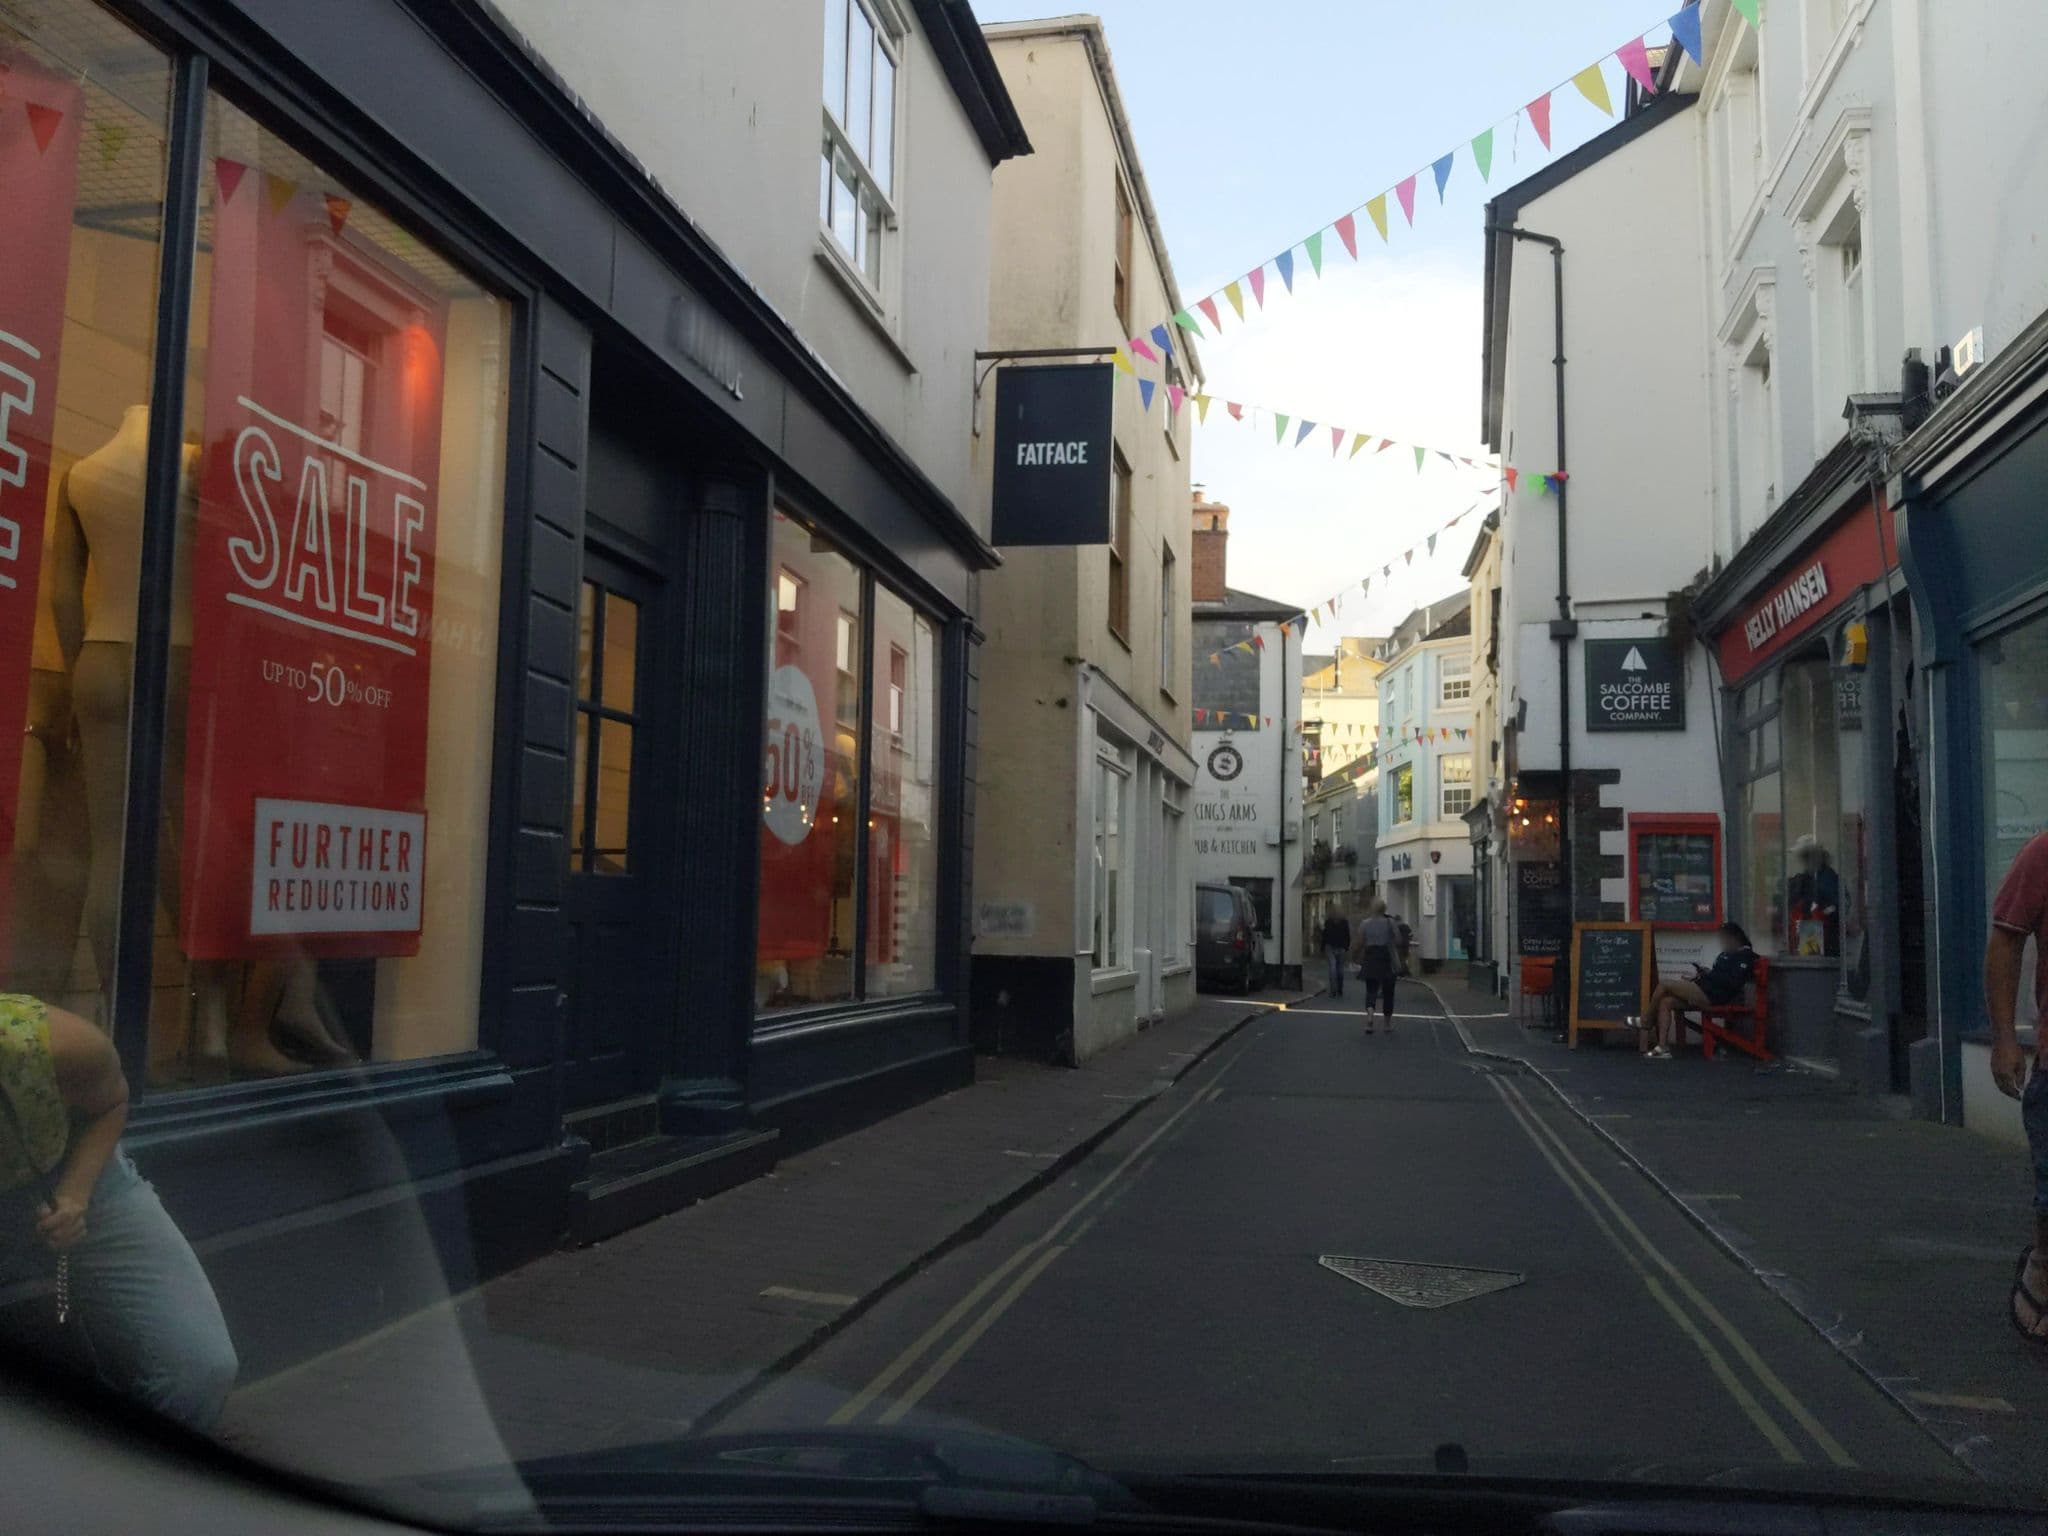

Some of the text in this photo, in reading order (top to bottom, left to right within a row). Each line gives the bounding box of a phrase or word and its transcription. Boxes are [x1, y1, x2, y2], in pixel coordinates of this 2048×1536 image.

[1016, 440, 1089, 466] FATFACE
[228, 425, 424, 636] SALE
[1744, 561, 1828, 660] HELLY HANSEN
[262, 659, 393, 709] UP TO 50% OFF
[1600, 681, 1671, 695] SALCOMBE
[1628, 675, 1643, 684] THE
[1601, 694, 1671, 711] COFFEE
[1229, 803, 1257, 822] ARMS
[268, 820, 411, 873] FURTHER
[1194, 839, 1209, 854] UB
[1220, 839, 1257, 855] KITCHEN
[267, 877, 410, 912] REDUCTIONS
